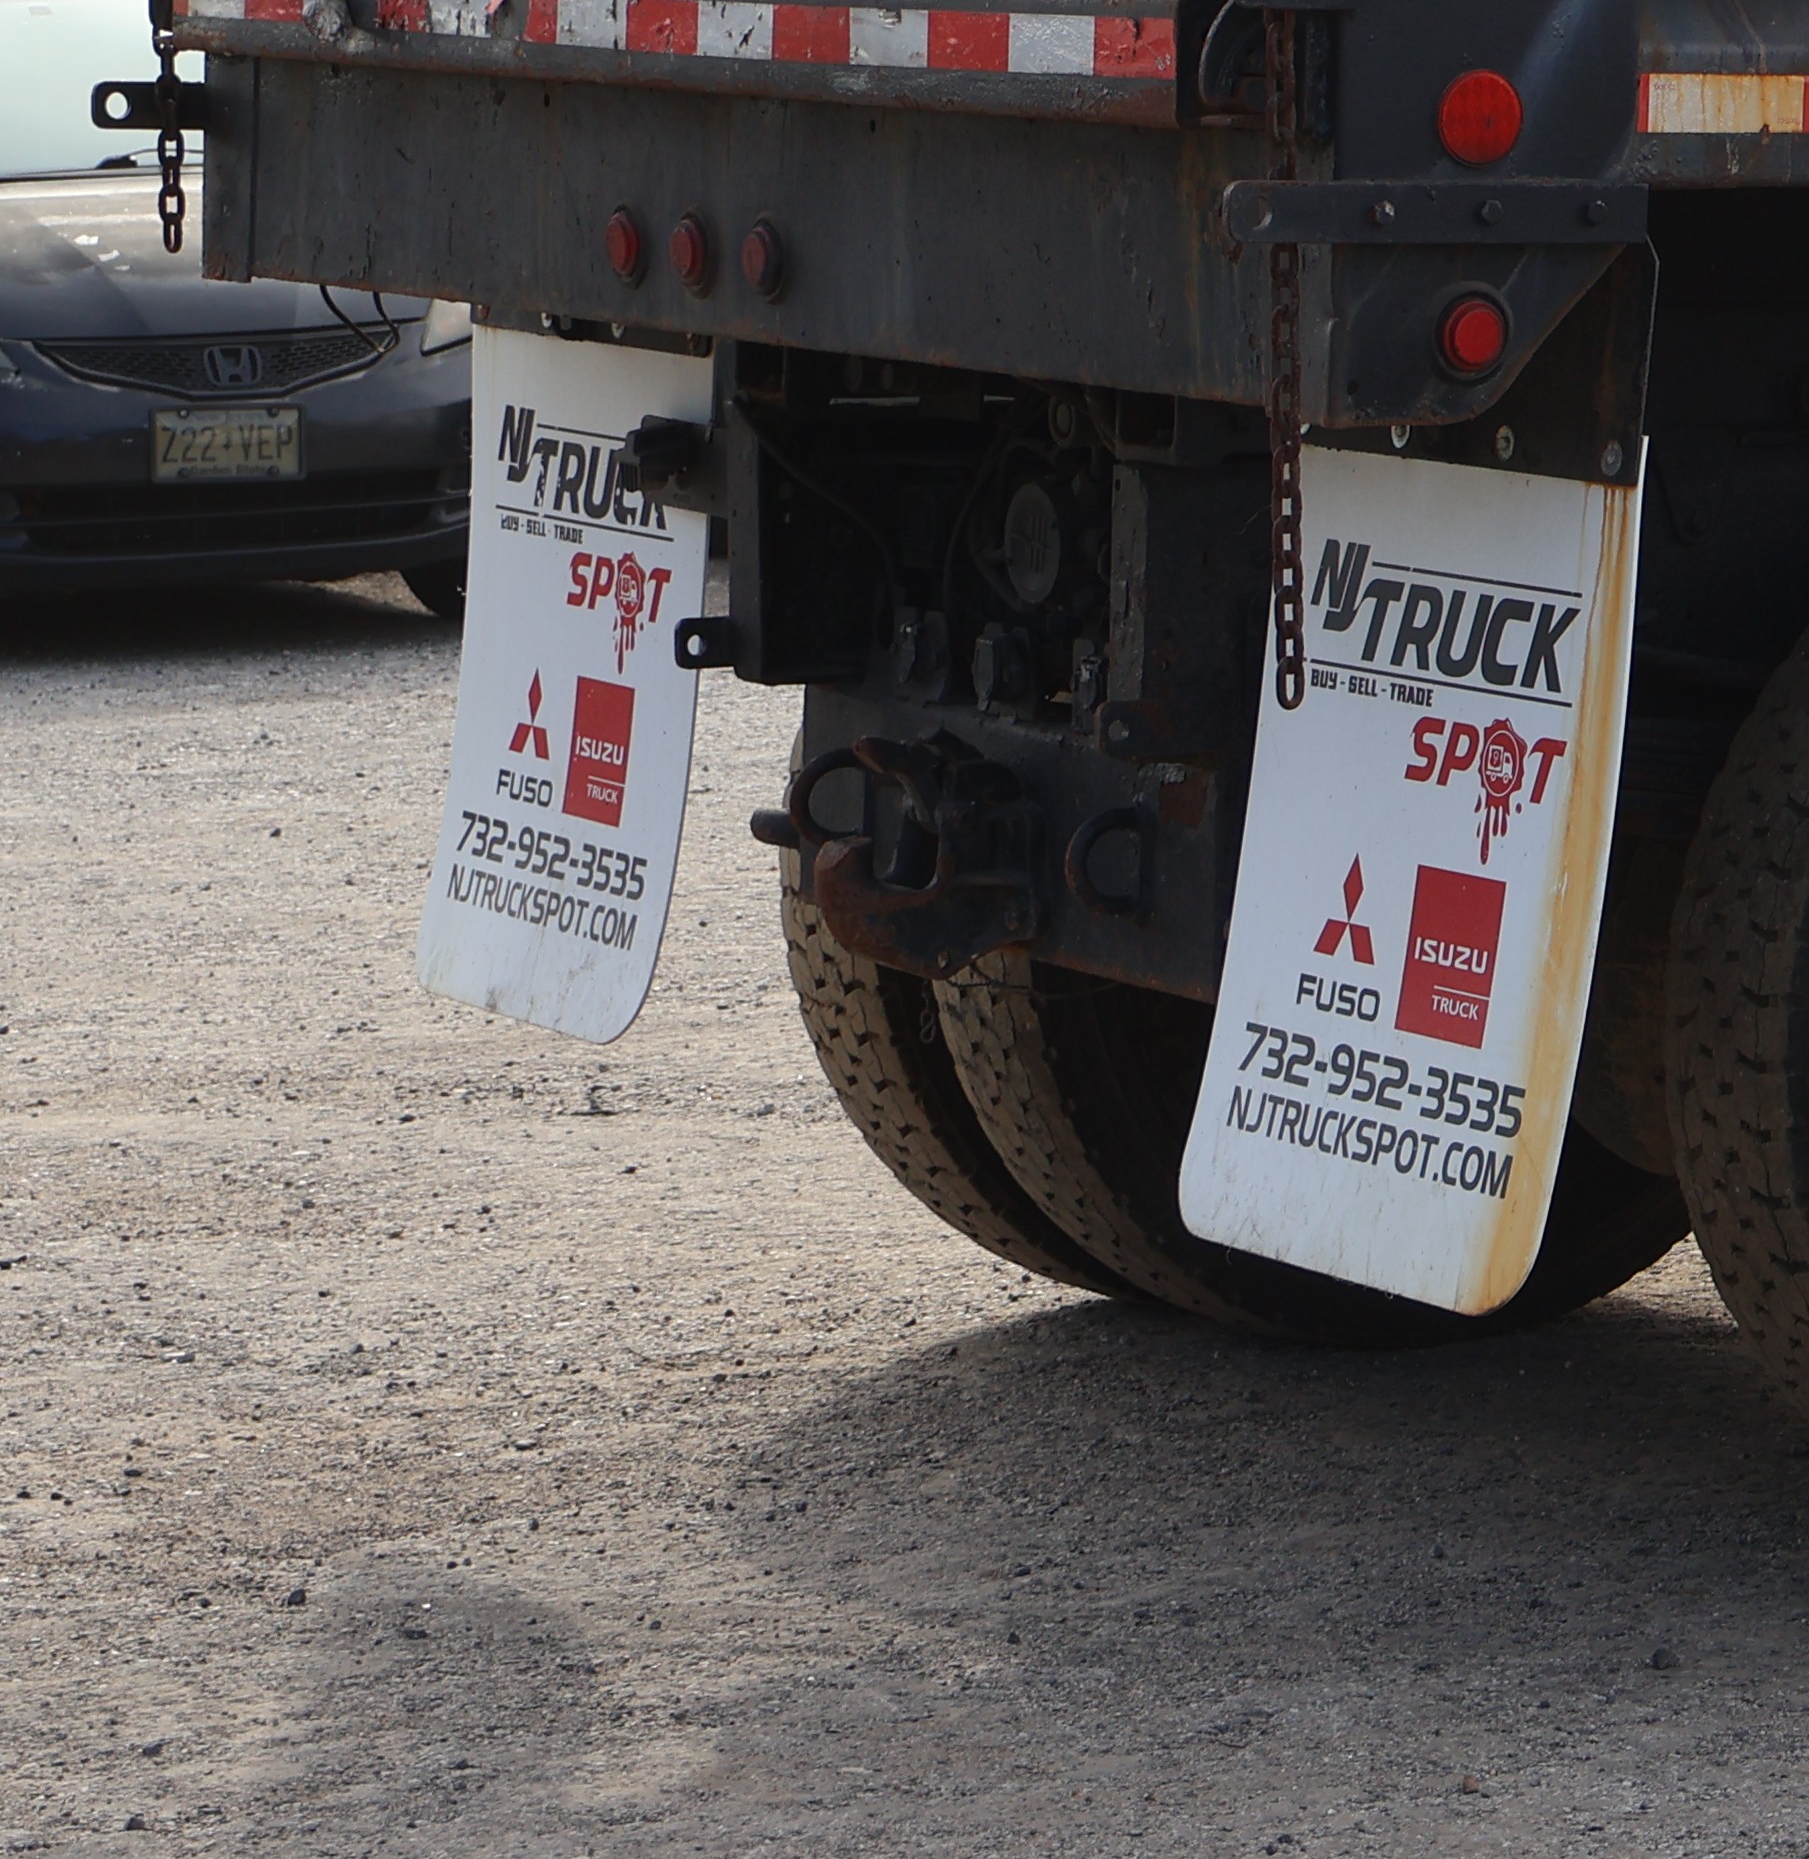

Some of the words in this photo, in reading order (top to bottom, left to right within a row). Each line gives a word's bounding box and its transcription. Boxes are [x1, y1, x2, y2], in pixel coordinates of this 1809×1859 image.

[501, 513, 519, 531] BUY
[526, 517, 547, 537] SELL
[554, 523, 583, 545] TRADE
[1311, 667, 1338, 691] BUY
[1349, 677, 1378, 698] SELL
[1389, 682, 1434, 708] TRADE
[575, 732, 625, 767] ISUZU
[496, 769, 553, 809] FUSO
[586, 782, 620, 806] TRUCK
[455, 810, 648, 902] 732-952-3535
[446, 863, 638, 952] NJTRUCKSPOT.COM
[1415, 936, 1489, 975] ISUZU
[1295, 975, 1381, 1023] FUSO
[1430, 993, 1480, 1023] TRUCK
[1237, 1021, 1527, 1140] 732-952-3535
[1226, 1083, 1514, 1200] NJTRUCKSPOT.COM
